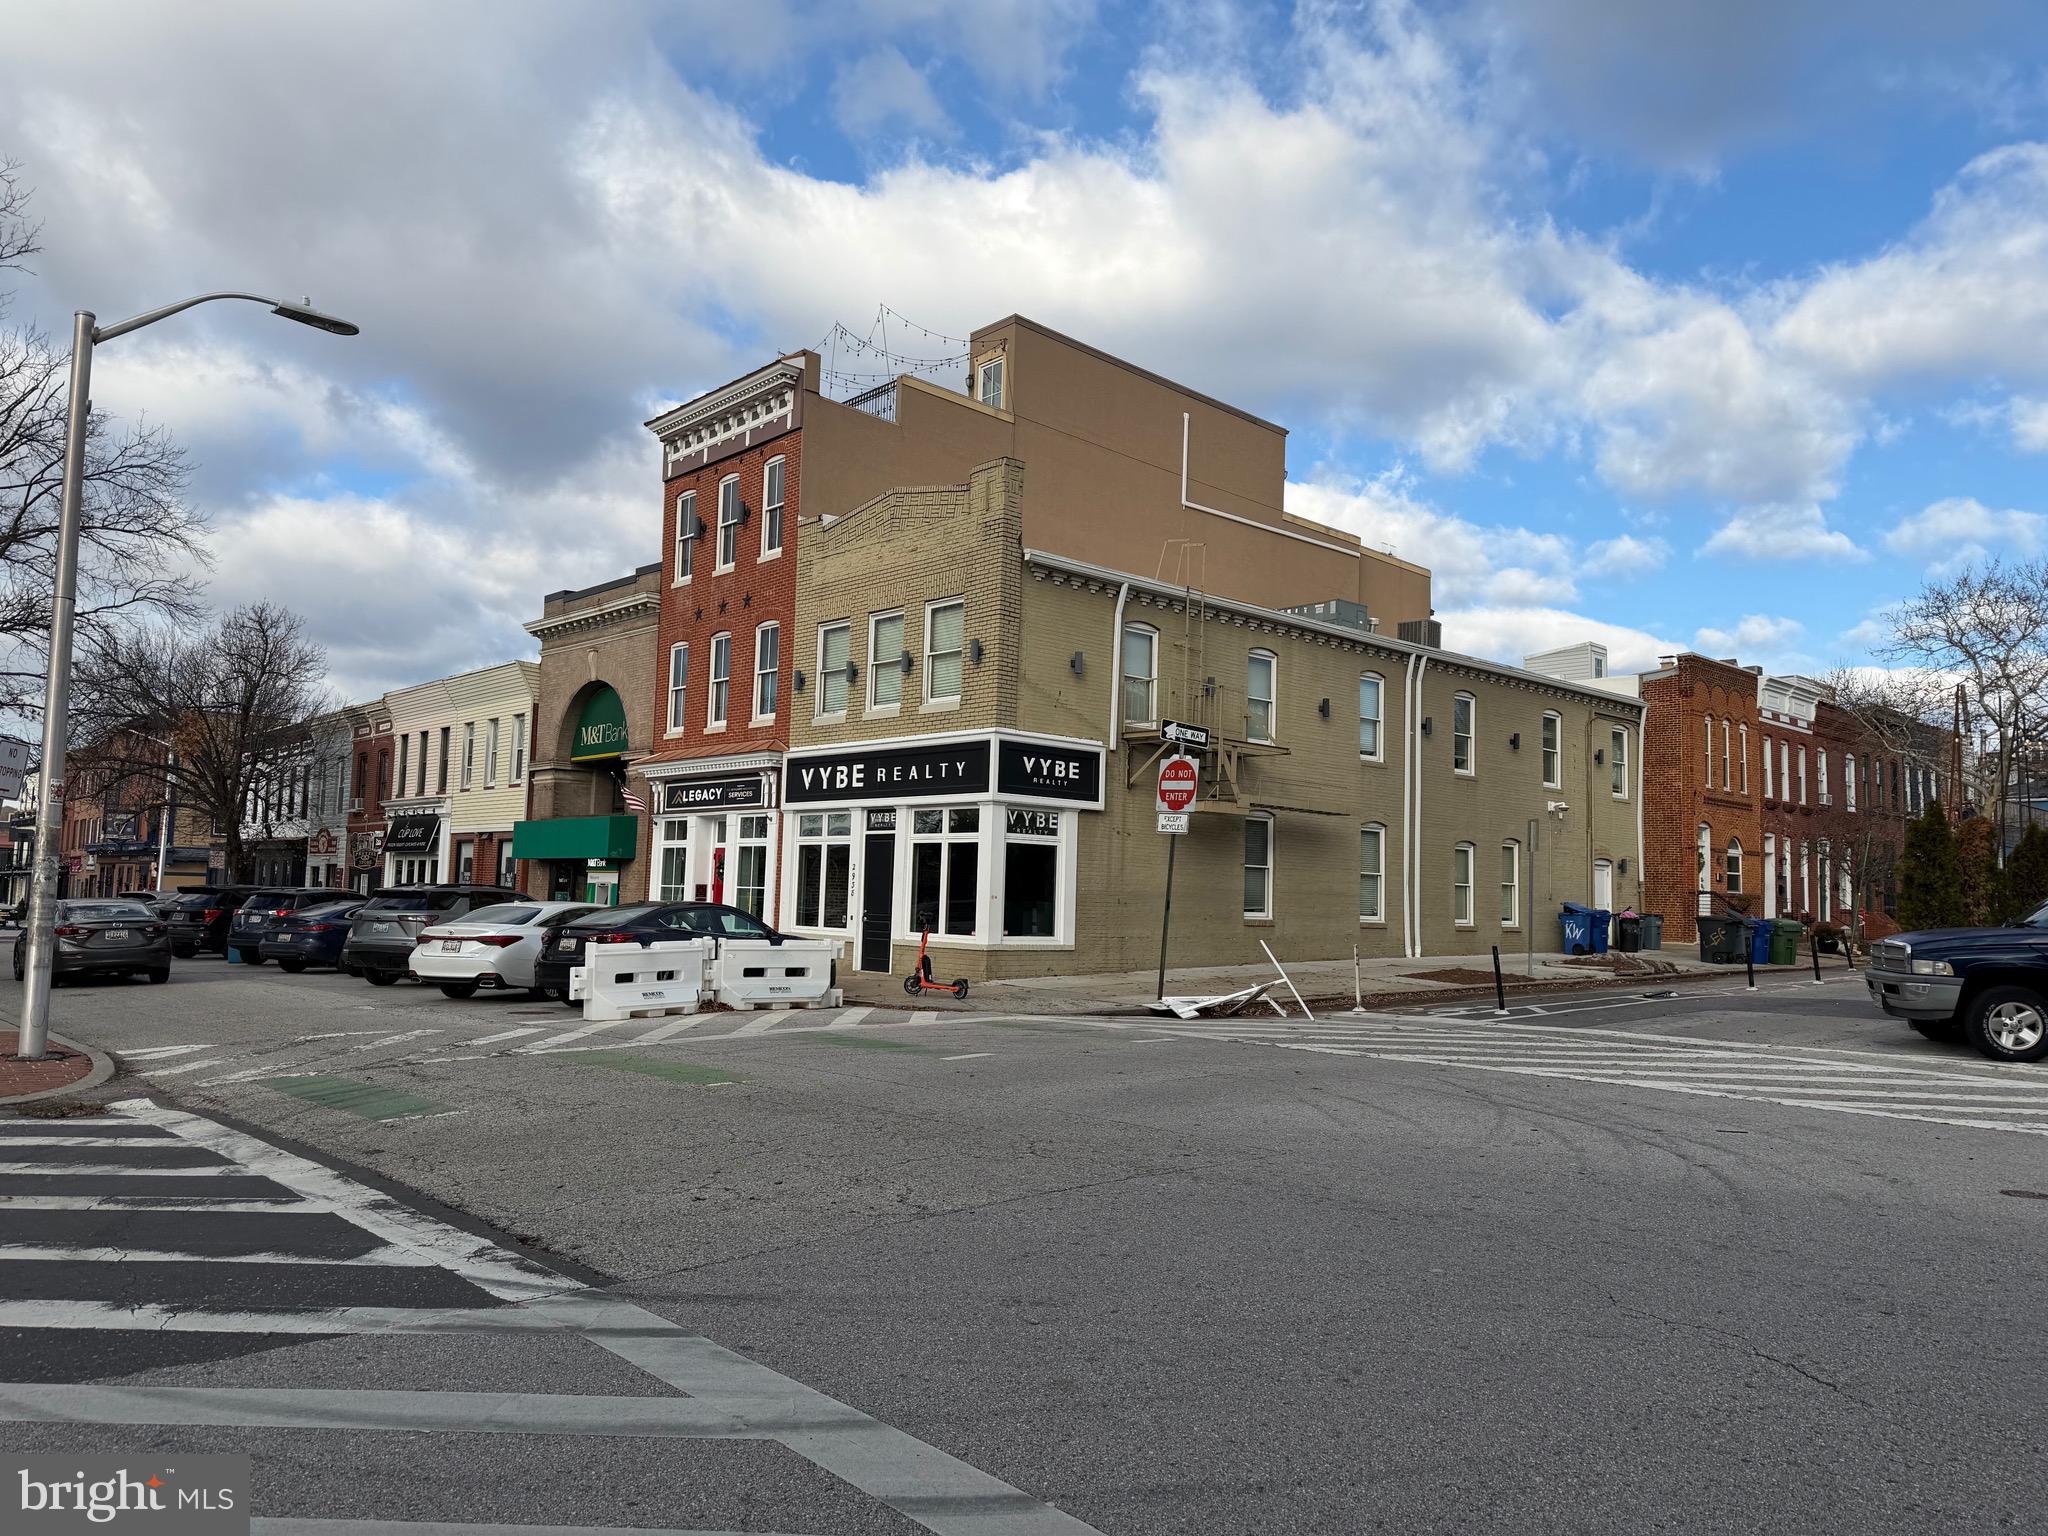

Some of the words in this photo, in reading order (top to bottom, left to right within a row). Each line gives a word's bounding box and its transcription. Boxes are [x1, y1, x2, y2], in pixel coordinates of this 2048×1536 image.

[581, 724, 605, 746] M&T
[605, 720, 628, 743] Bank
[1175, 728, 1188, 737] ONE
[1190, 732, 1205, 741] WAY
[9, 748, 18, 759] NO
[0, 766, 22, 779] TOPPING
[1023, 756, 1080, 779] VYBE
[801, 763, 865, 791] VYBE
[877, 761, 966, 782] REALTY
[1165, 769, 1175, 778] DO
[1178, 769, 1193, 778] NOT
[1033, 777, 1068, 787] REALTY
[682, 787, 723, 802] LEGACY
[728, 790, 753, 799] SERVICES
[1165, 792, 1188, 801] ENTER
[870, 812, 896, 823] VYBE
[1007, 809, 1058, 829] VYBE
[1163, 815, 1182, 823] EXCEPT
[1160, 823, 1184, 831] BICYCLES
